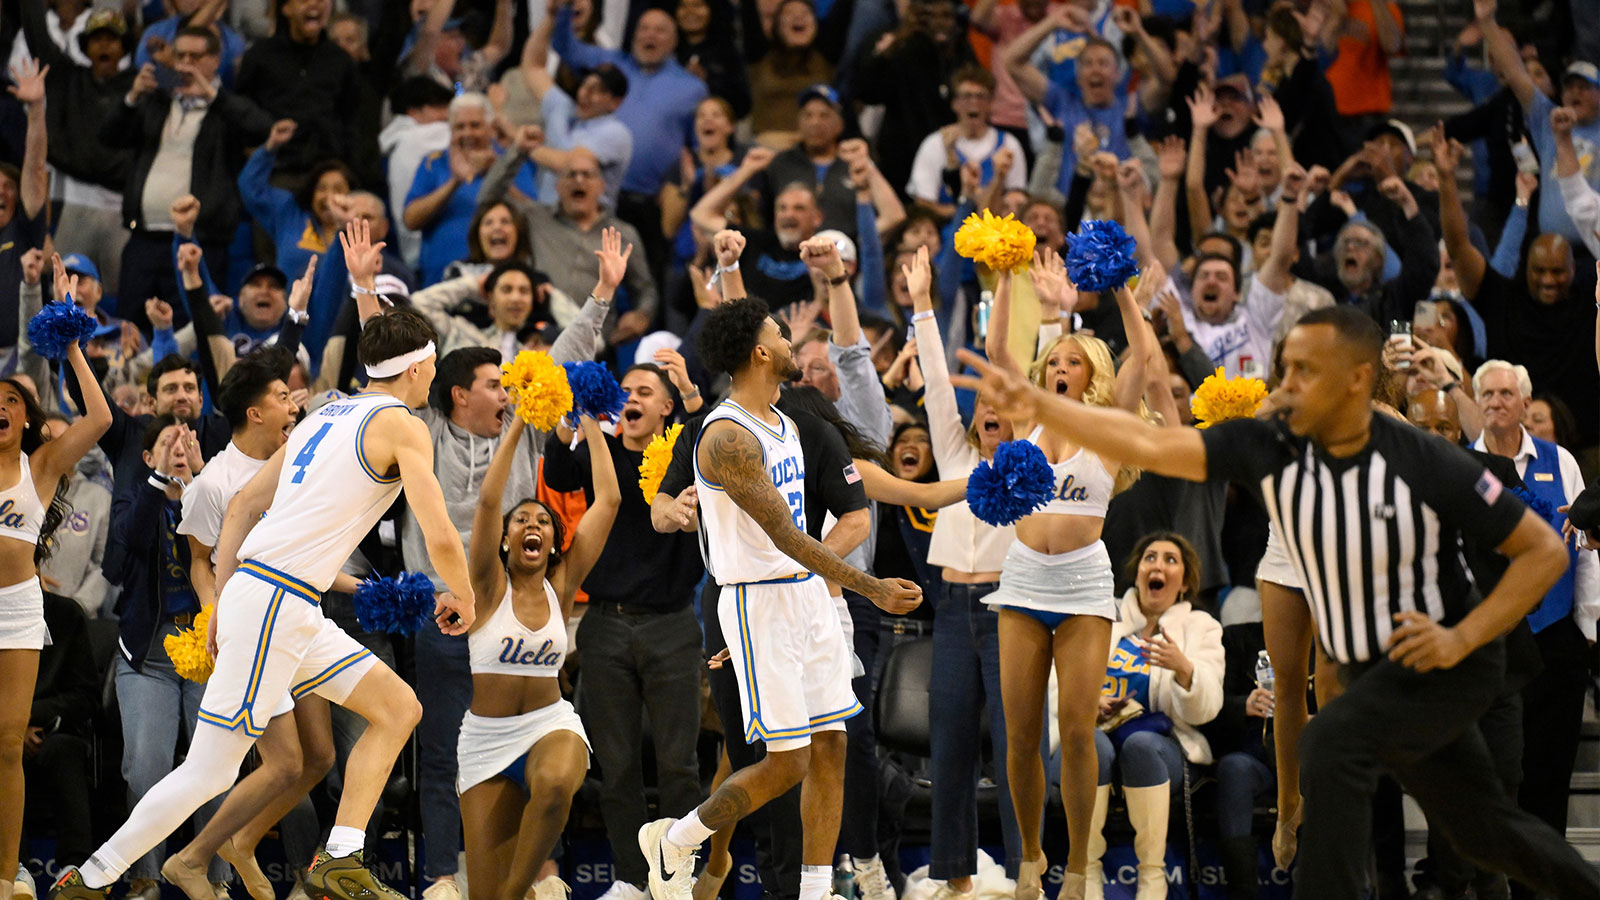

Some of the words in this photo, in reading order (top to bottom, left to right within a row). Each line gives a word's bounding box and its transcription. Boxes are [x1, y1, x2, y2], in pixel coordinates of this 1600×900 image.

[291, 422, 334, 484] 4
[771, 456, 805, 488] UCL
[1052, 474, 1088, 502] la
[0, 499, 24, 528] la
[787, 491, 804, 532] 2
[499, 636, 561, 666] Ucla
[1107, 648, 1150, 676] CL
